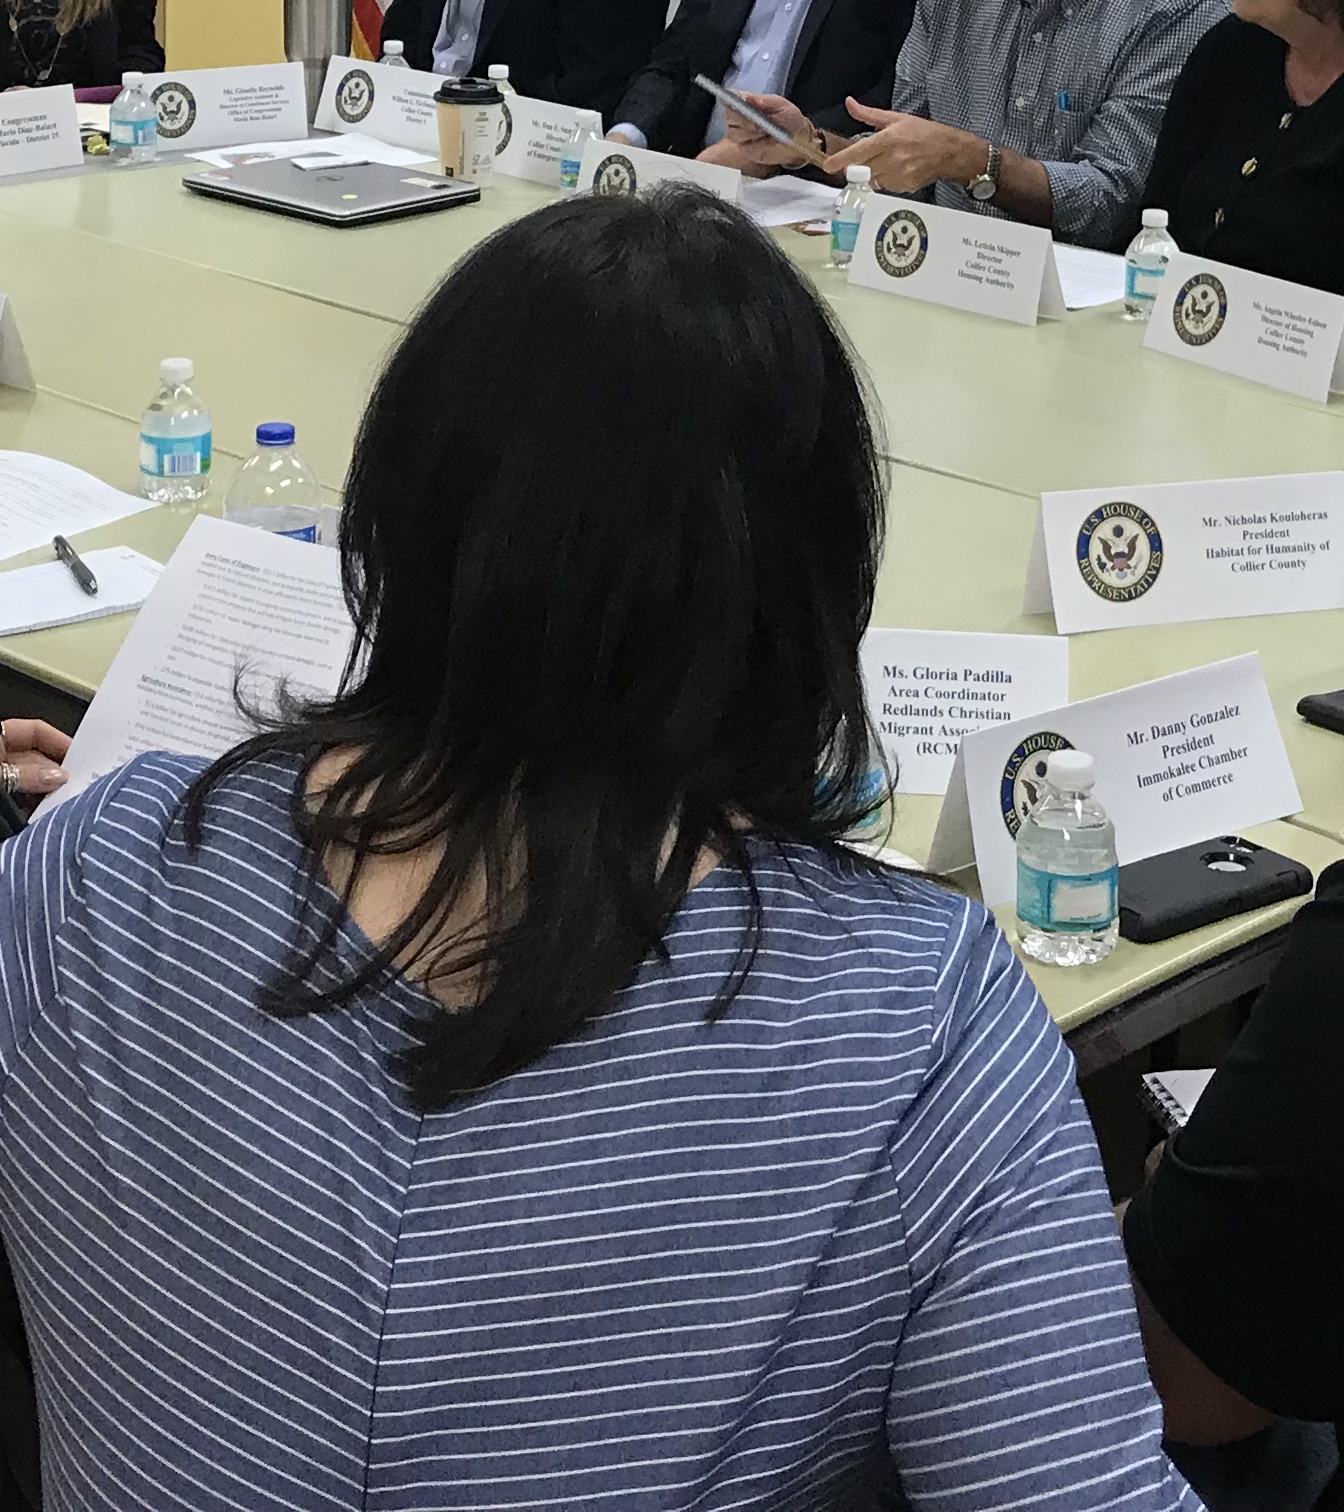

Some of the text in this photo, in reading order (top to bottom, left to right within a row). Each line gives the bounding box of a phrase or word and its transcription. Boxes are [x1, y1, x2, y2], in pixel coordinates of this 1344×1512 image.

[1101, 502, 1144, 522] HOUSE
[1202, 516, 1221, 528] Mr.
[1224, 513, 1267, 527] Nicholas
[1242, 528, 1290, 541] President
[1206, 540, 1331, 559] Habitat for Humanity of
[1231, 556, 1308, 573] Collier County
[882, 665, 1012, 684] Ms. Gloria Padilla
[887, 686, 1007, 702] Area Coordinator
[882, 703, 1011, 721] Redlands Christian
[879, 721, 933, 738] Migrant
[1126, 704, 1242, 748] Mr. Danny Gonzalez
[1161, 733, 1216, 759] President
[1136, 746, 1249, 788] Immokalee Chamber
[1162, 771, 1235, 802] of Commerce
